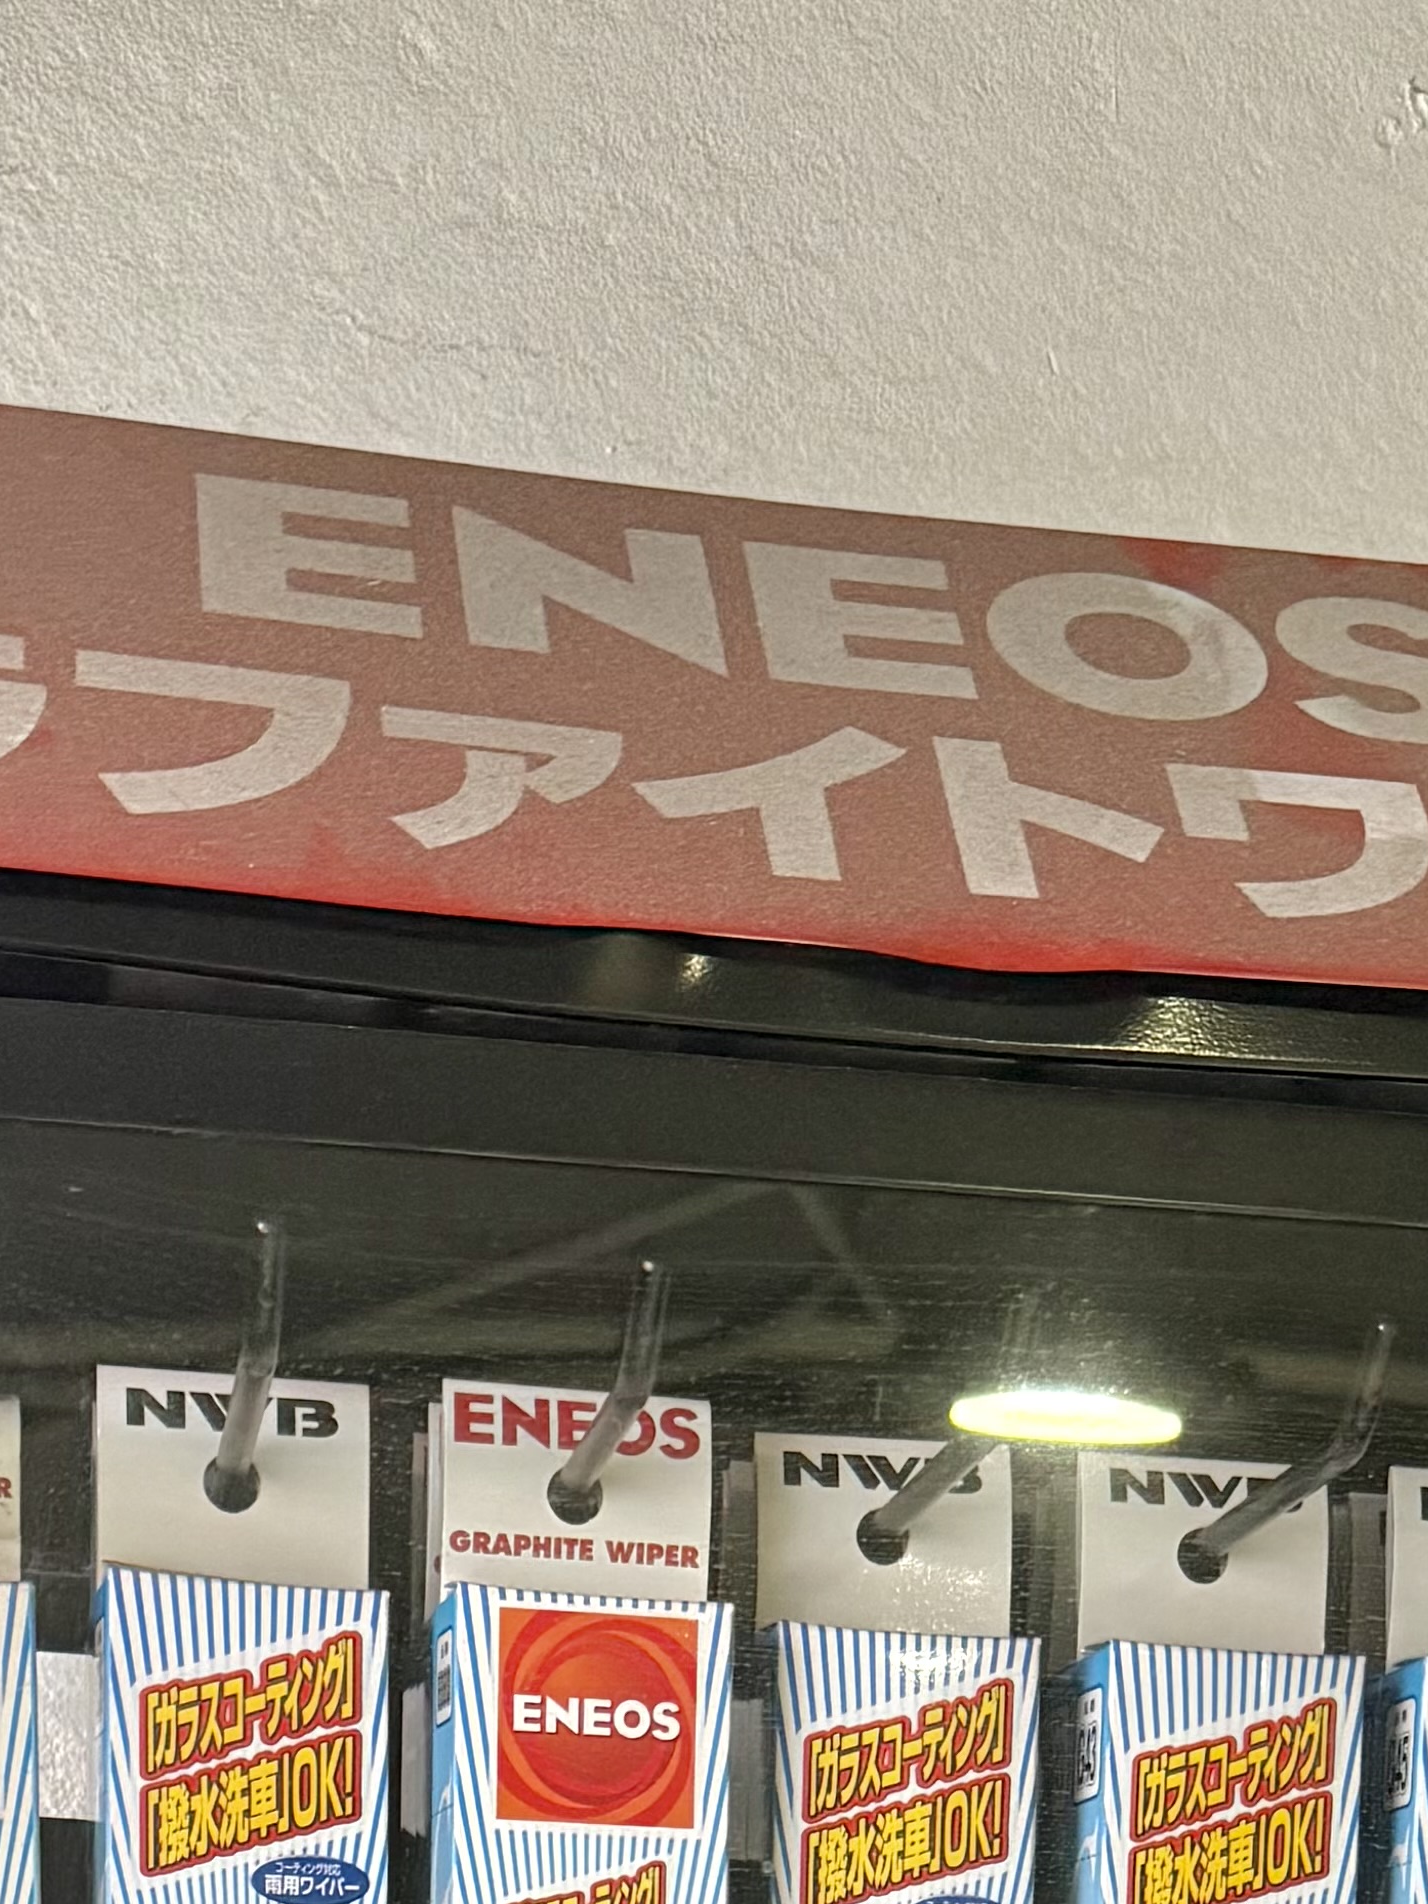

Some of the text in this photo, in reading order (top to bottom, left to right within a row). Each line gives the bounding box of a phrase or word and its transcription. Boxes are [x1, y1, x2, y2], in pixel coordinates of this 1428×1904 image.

[126, 1388, 339, 1438] NWB
[454, 1392, 699, 1459] ENEOS
[1110, 1469, 1303, 1513] NW
[449, 1530, 699, 1569] GRAPHITE WIPER
[513, 1695, 680, 1741] ENEOS
[264, 1874, 361, 1896] 雨用ワイパー
